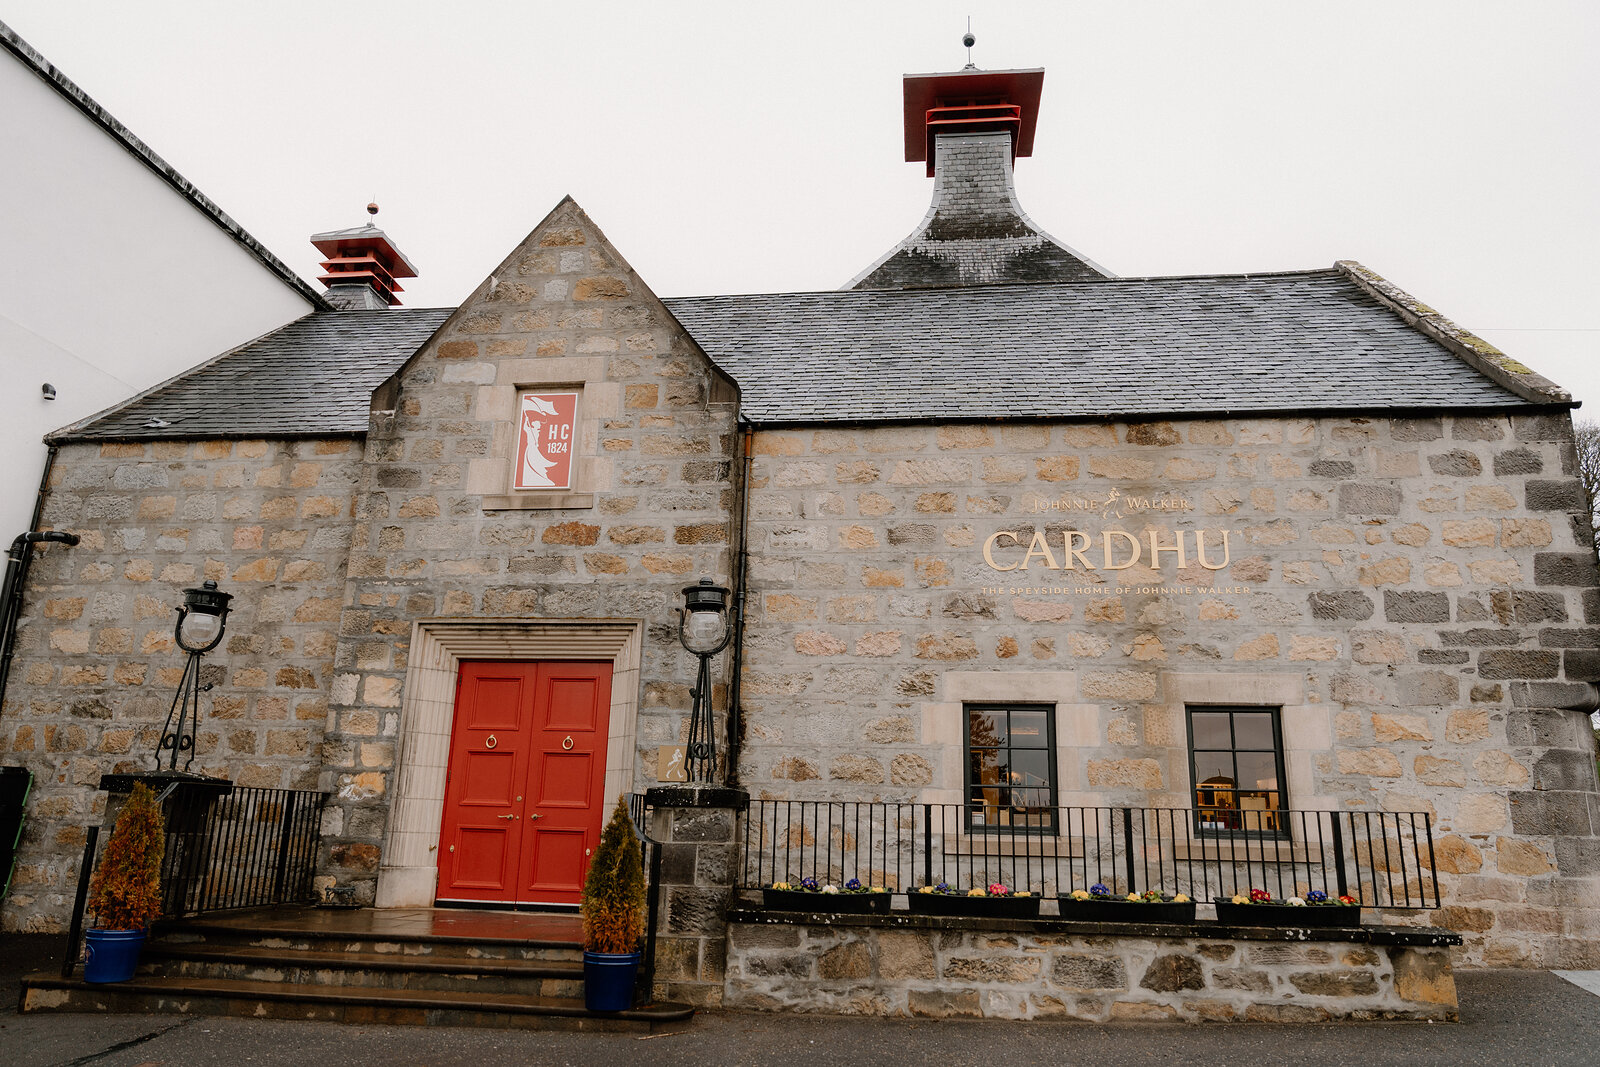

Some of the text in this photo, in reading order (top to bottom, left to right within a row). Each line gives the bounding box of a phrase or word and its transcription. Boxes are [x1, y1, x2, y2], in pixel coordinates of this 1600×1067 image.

[547, 442, 568, 454] 1824
[983, 530, 1230, 571] CARDHU
[982, 586, 1251, 595] THE SPEYSIDE HOME OF JOHNNIE WALKER
